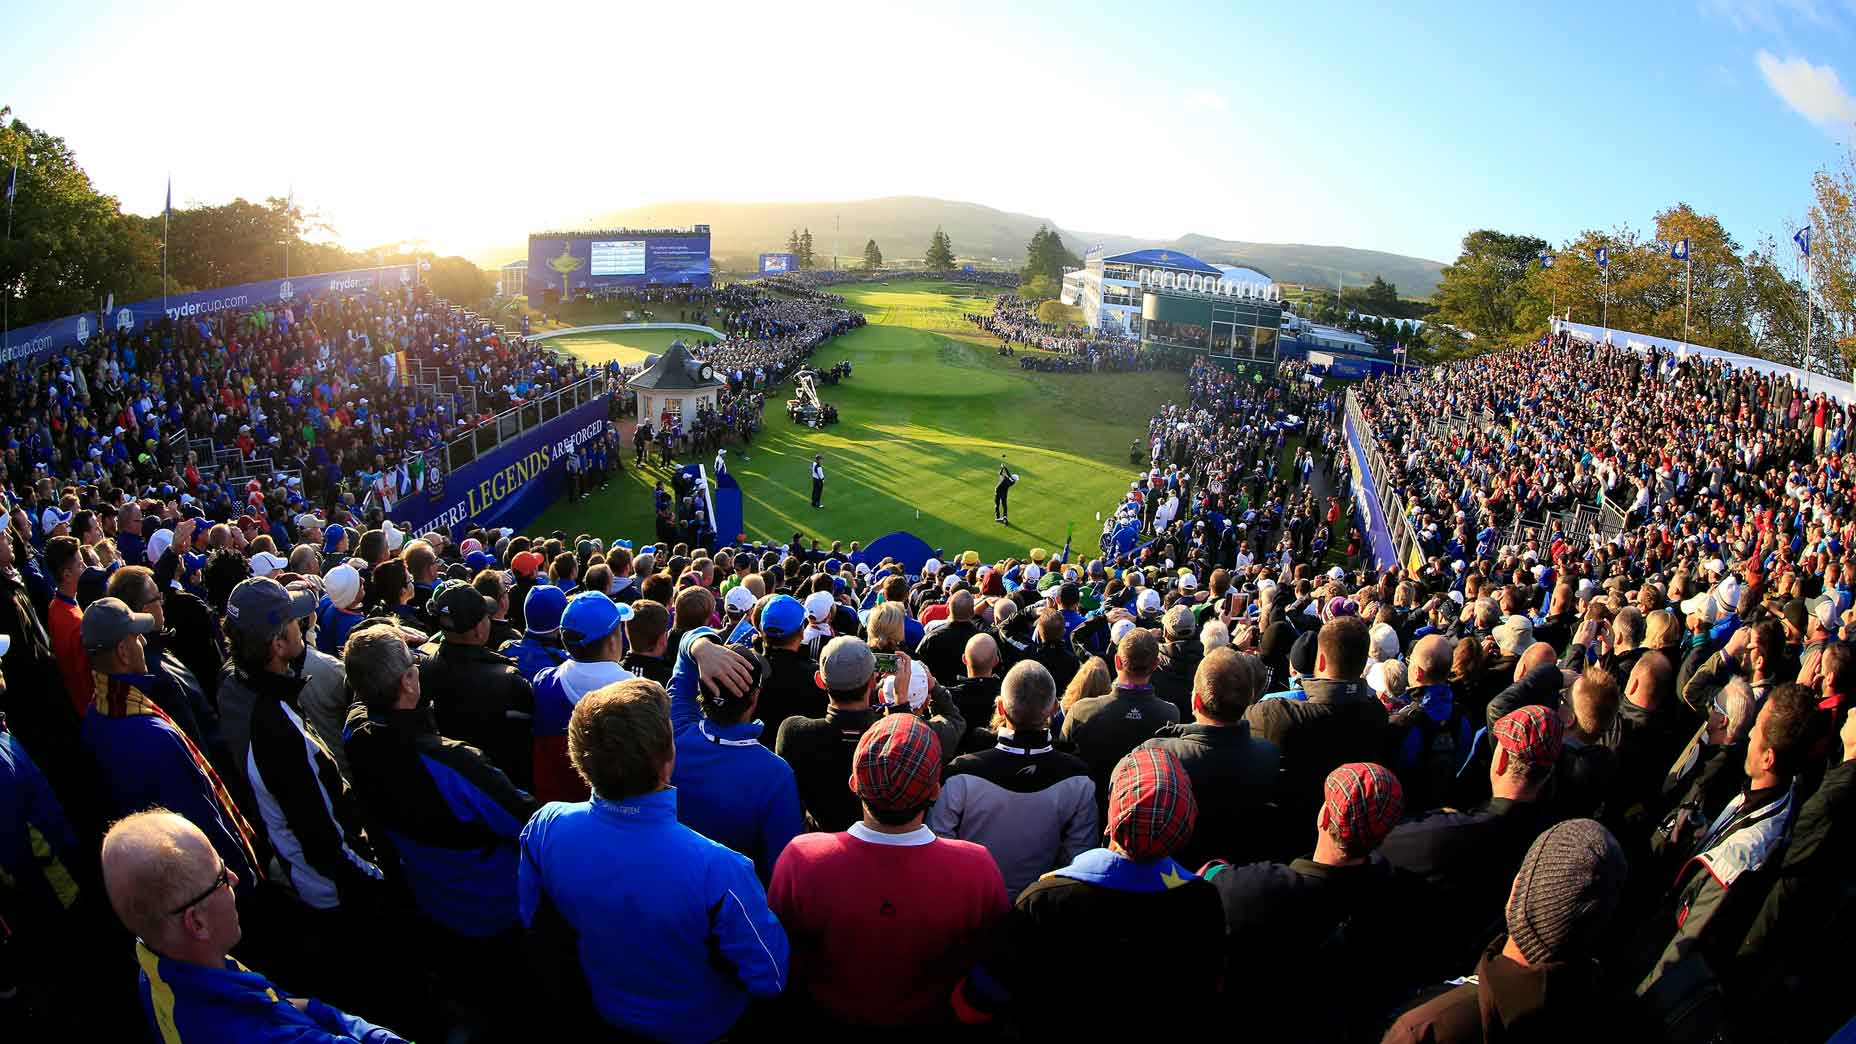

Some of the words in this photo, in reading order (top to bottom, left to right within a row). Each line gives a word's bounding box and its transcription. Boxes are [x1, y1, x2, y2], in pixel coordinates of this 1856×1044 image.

[166, 295, 248, 320] rydercup.com
[412, 500, 467, 539] WHERE
[466, 445, 550, 519] LEGENDS
[552, 438, 573, 461] ARE
[570, 419, 602, 446] FORGED
